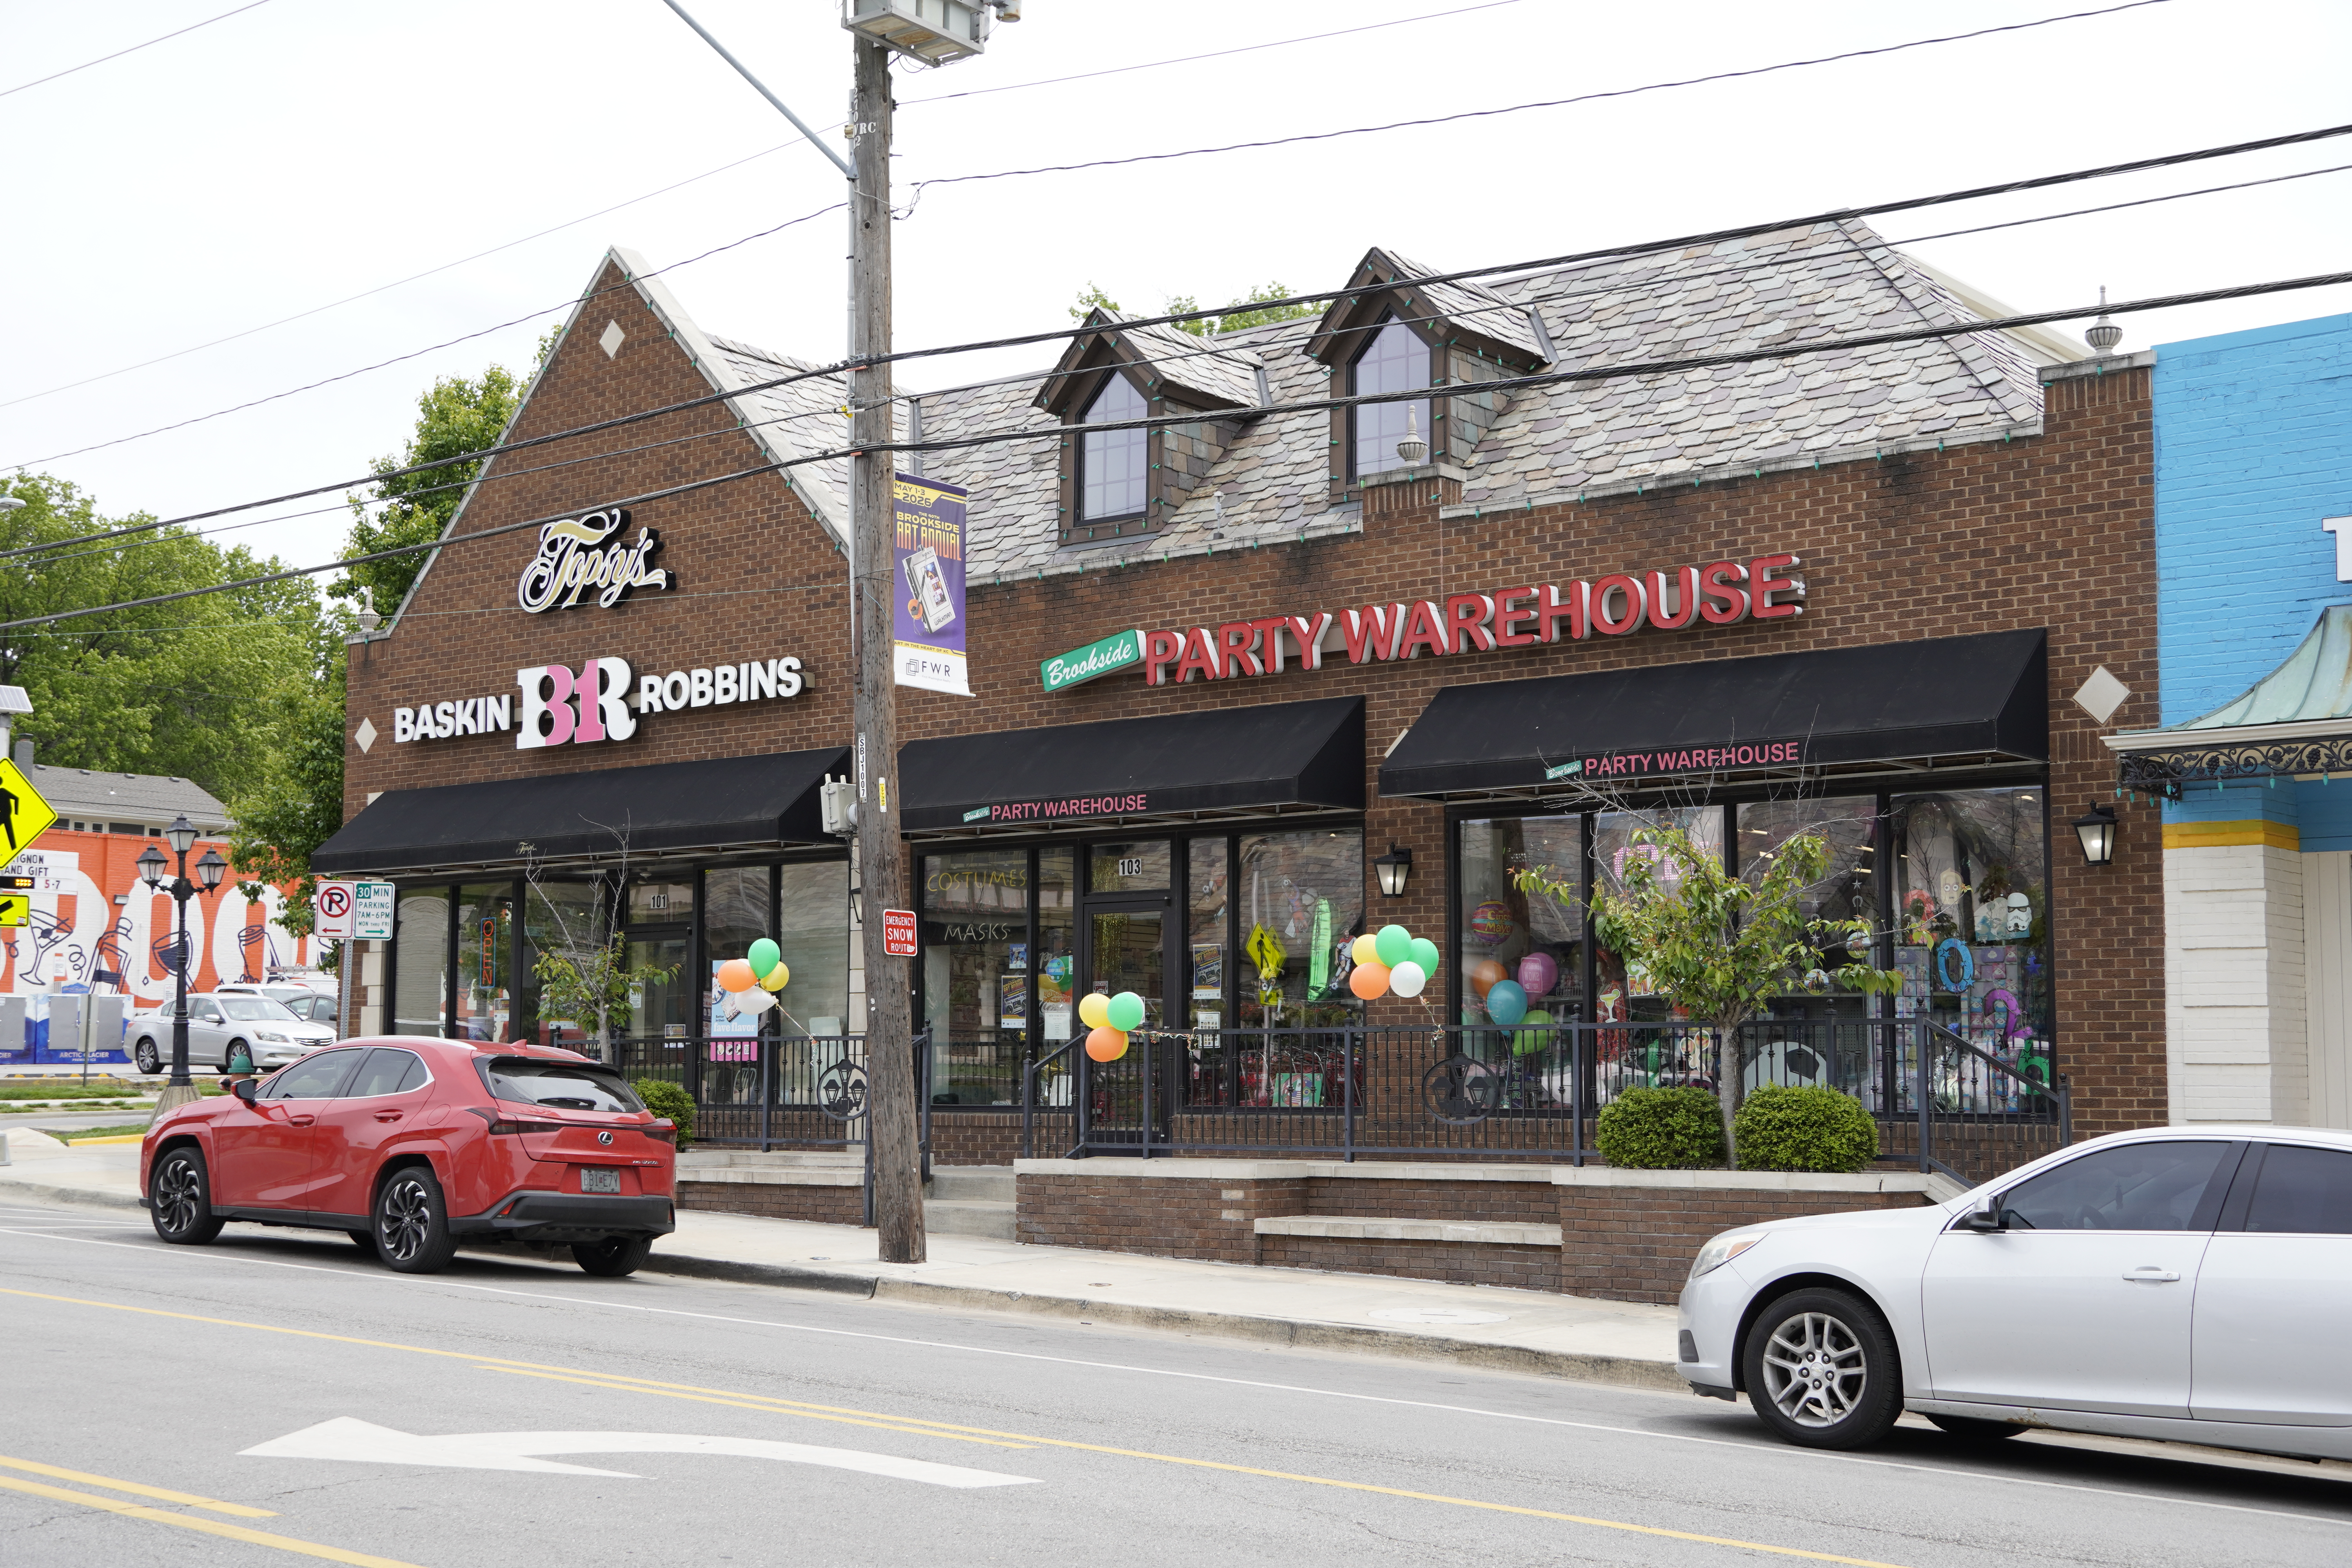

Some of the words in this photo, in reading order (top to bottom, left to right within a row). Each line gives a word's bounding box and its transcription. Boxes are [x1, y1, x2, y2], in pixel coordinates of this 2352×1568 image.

[895, 482, 913, 492] MAY
[915, 487, 925, 495] 1-3
[902, 492, 932, 507] 2026
[897, 511, 960, 534] BROOKSIDE
[897, 521, 918, 552] ART
[921, 526, 962, 561] ANNUAL
[518, 508, 667, 613] Topsy's
[934, 612, 953, 626] WALKMAN
[1047, 639, 1133, 686] Brookside
[1146, 611, 1326, 686] PARTY
[1339, 554, 1798, 664] WAREHOUSE
[922, 661, 951, 677] FWR
[395, 695, 511, 744] BASKIN
[640, 656, 803, 714] ROBBINS
[1548, 764, 1581, 779] Brookside
[1585, 753, 1652, 776] PARTY
[1657, 742, 1798, 771] WAREHOUSE
[964, 808, 989, 821] Brookside
[992, 802, 1041, 821] PARTY
[1044, 794, 1147, 817] WAREHOUSE
[4, 865, 22, 875] AND
[29, 866, 49, 877] GIFT
[1121, 859, 1141, 875] 103
[45, 879, 61, 889] 5-7
[927, 869, 1026, 892] COSTUMES
[358, 887, 370, 898] 30
[373, 888, 389, 897] MIN
[652, 895, 666, 908] 101
[886, 915, 914, 926] EMERGENCY
[1487, 910, 1512, 920] Cinco
[887, 927, 913, 942] SNOW
[944, 923, 1008, 941] MASKS
[1485, 922, 1511, 937] Mayo
[483, 920, 494, 985] OPEN
[1195, 946, 1217, 958] BROOKSIDE
[1203, 949, 1220, 962] ANNUAL
[1003, 978, 1023, 988] BROOKSIDE
[1011, 980, 1025, 991] ANNUAL
[713, 1022, 730, 1032] fave
[731, 1022, 756, 1032] flavor
[584, 1173, 598, 1187] BB1
